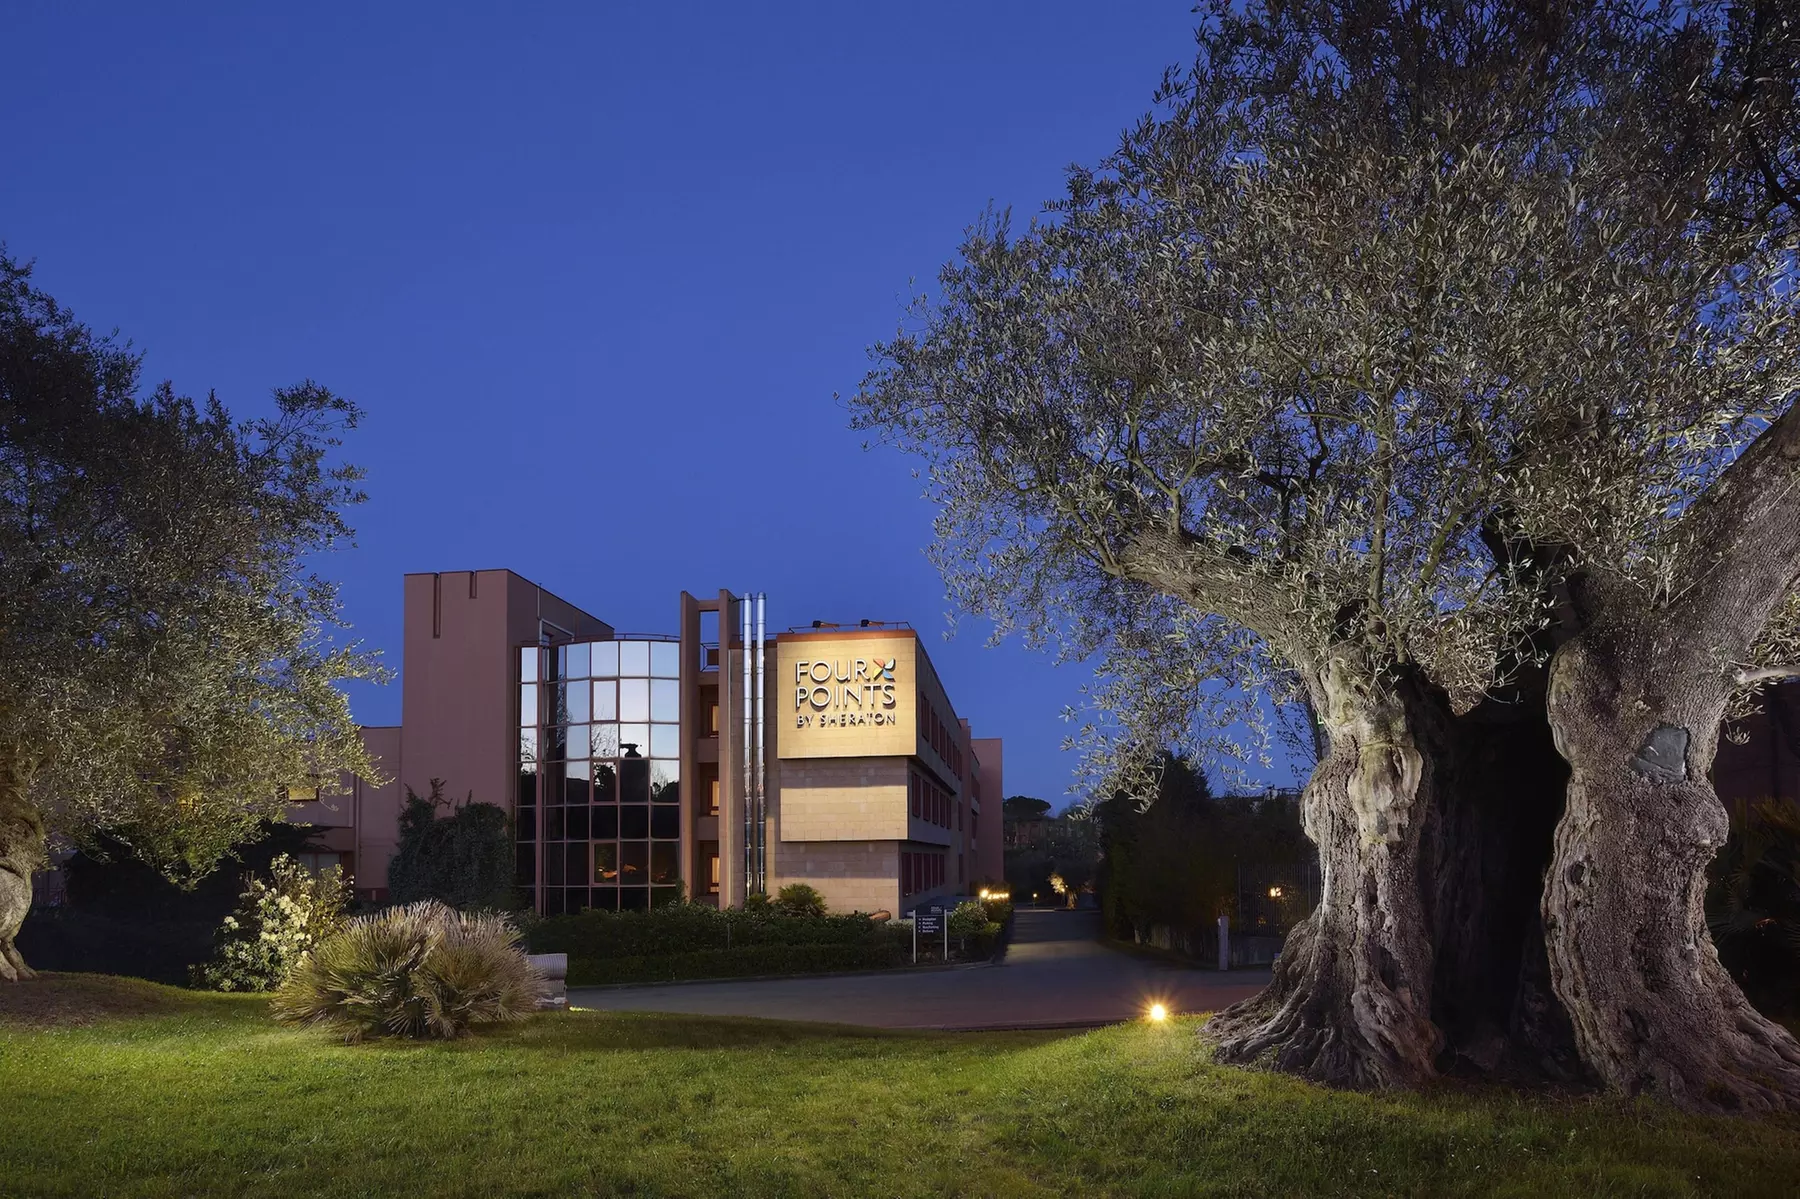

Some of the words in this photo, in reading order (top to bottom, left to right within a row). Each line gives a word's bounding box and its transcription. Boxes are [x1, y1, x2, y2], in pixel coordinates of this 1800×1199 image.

[796, 659, 870, 683] FOUR
[796, 683, 896, 709] POINTS
[797, 714, 813, 727] BY
[820, 712, 896, 727] SHERATON
